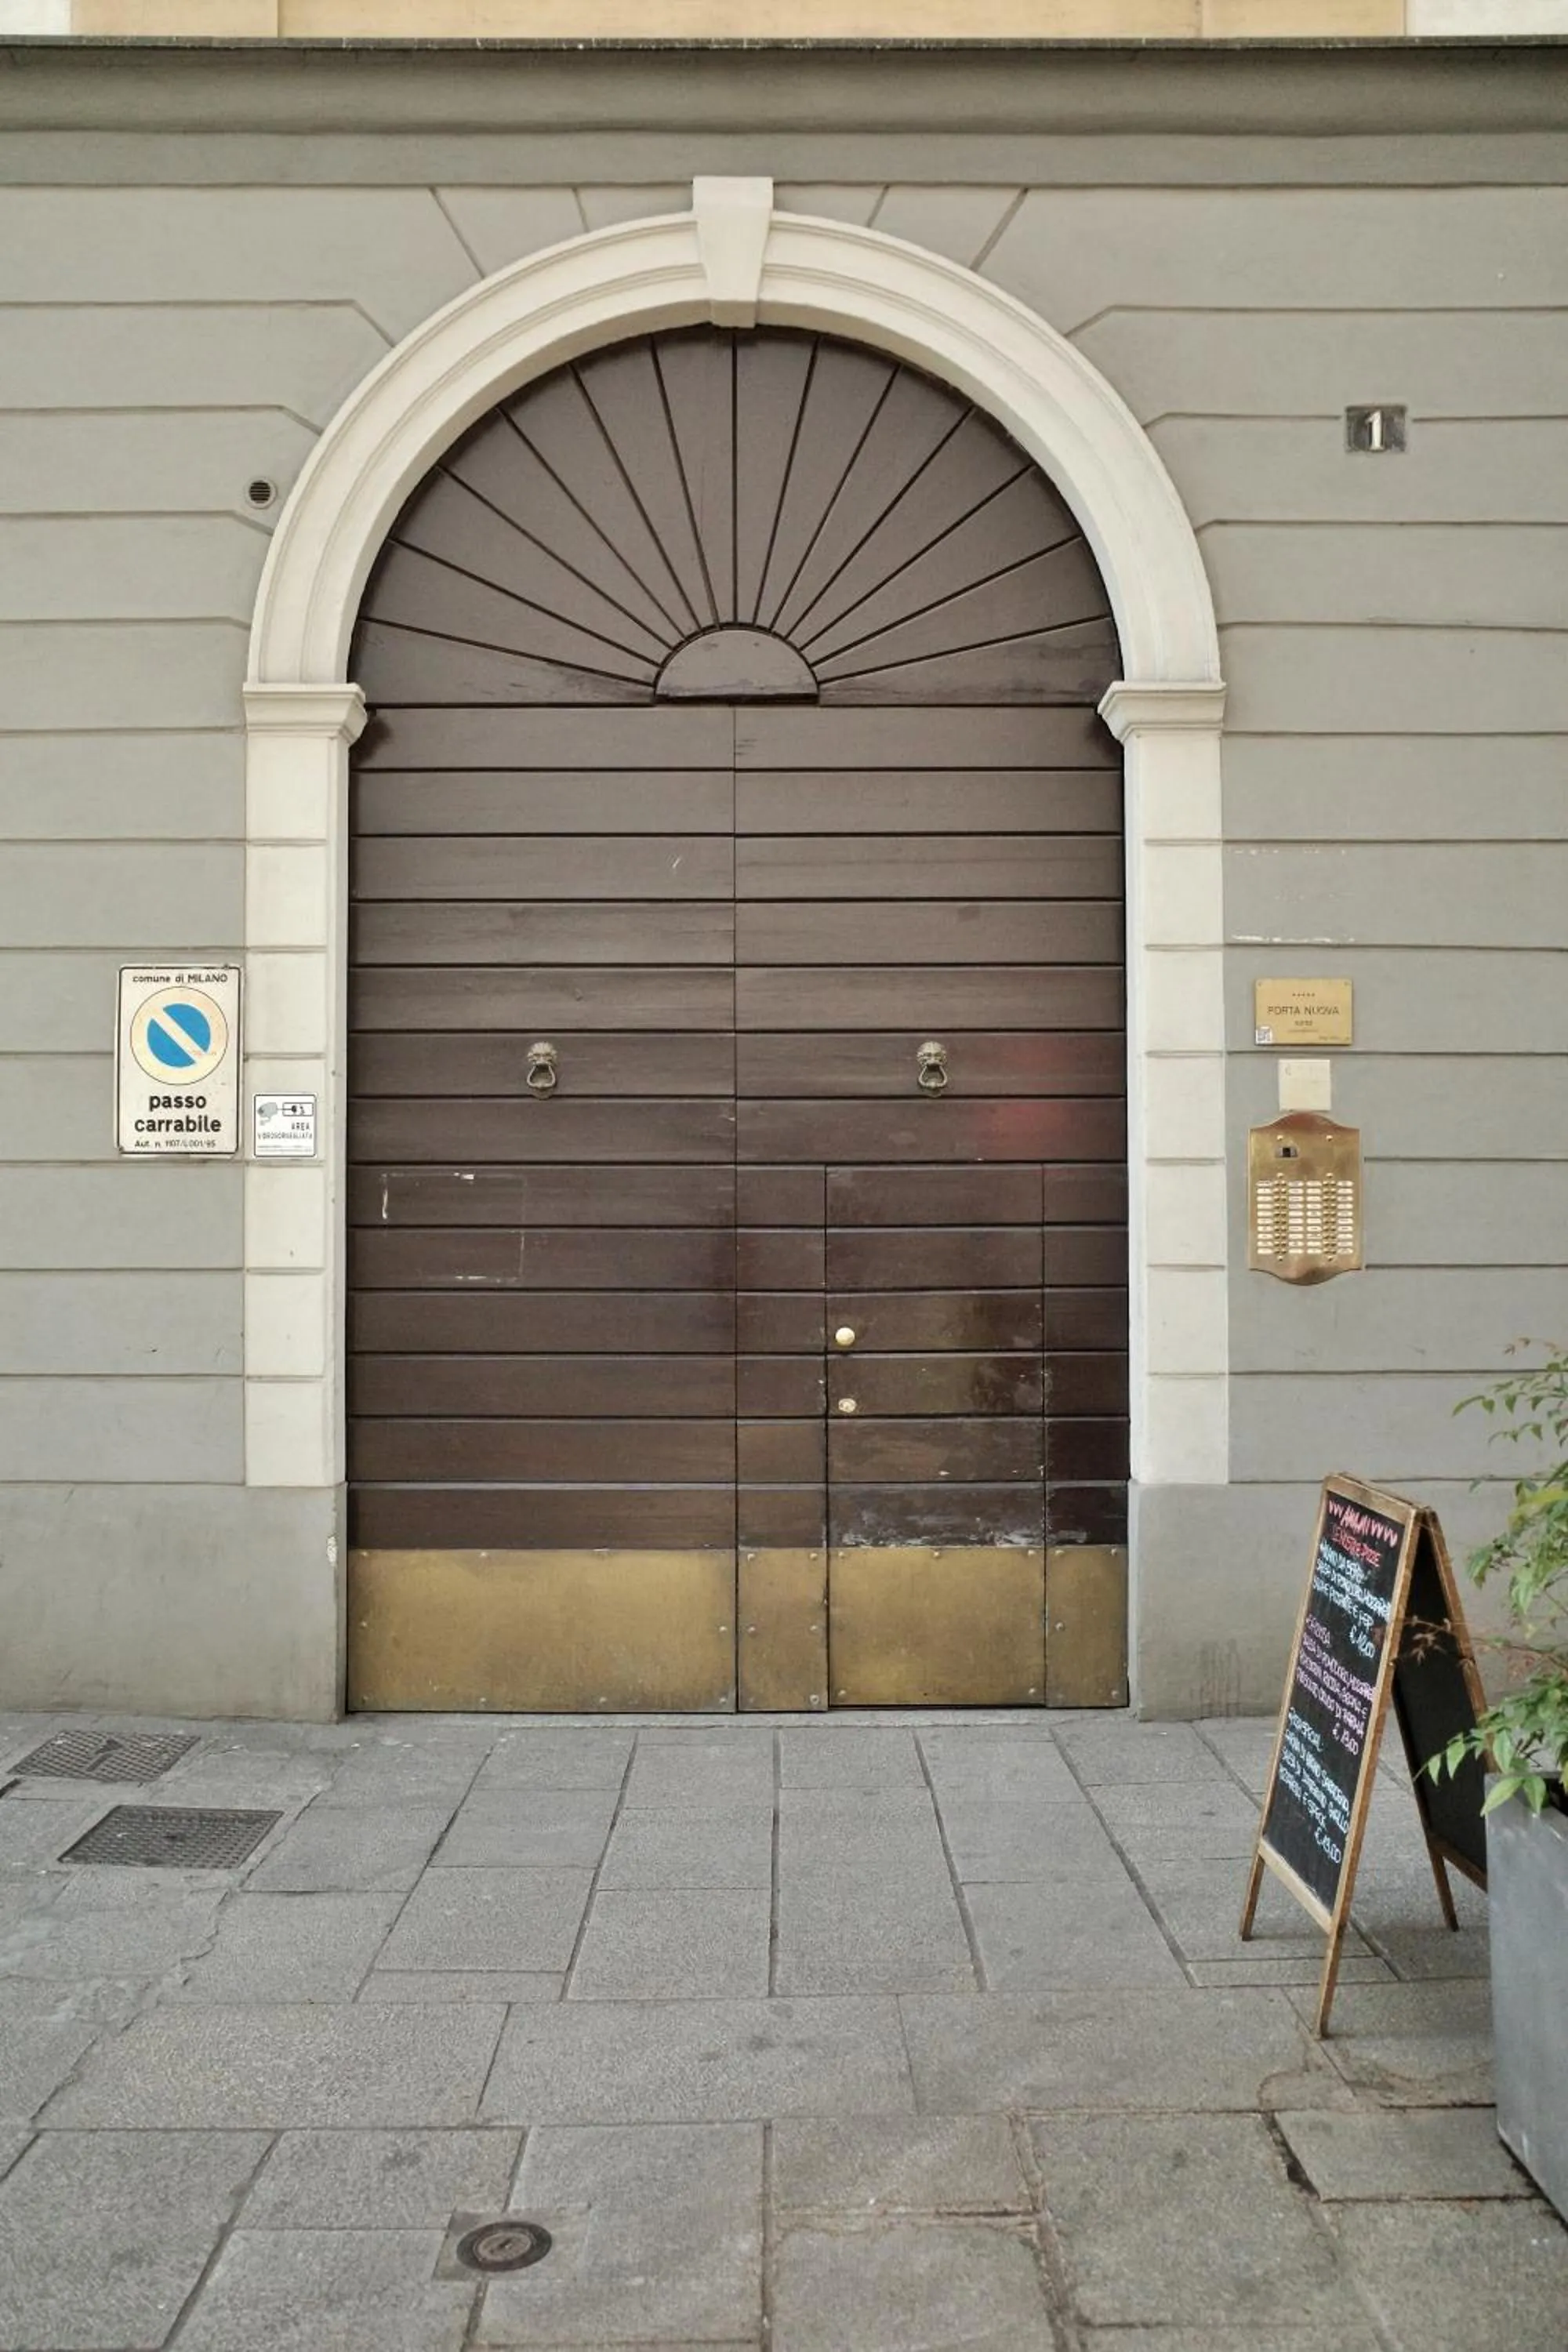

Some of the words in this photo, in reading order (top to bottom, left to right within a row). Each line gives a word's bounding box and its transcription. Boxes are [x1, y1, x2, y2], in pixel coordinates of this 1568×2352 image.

[1365, 409, 1384, 450] 1
[175, 974, 184, 983] di
[187, 974, 228, 982] MILANO
[1267, 1006, 1301, 1015] PORTA
[1304, 1006, 1340, 1016] NUOVA
[149, 1095, 206, 1112] passo
[134, 1115, 222, 1132] carrabile
